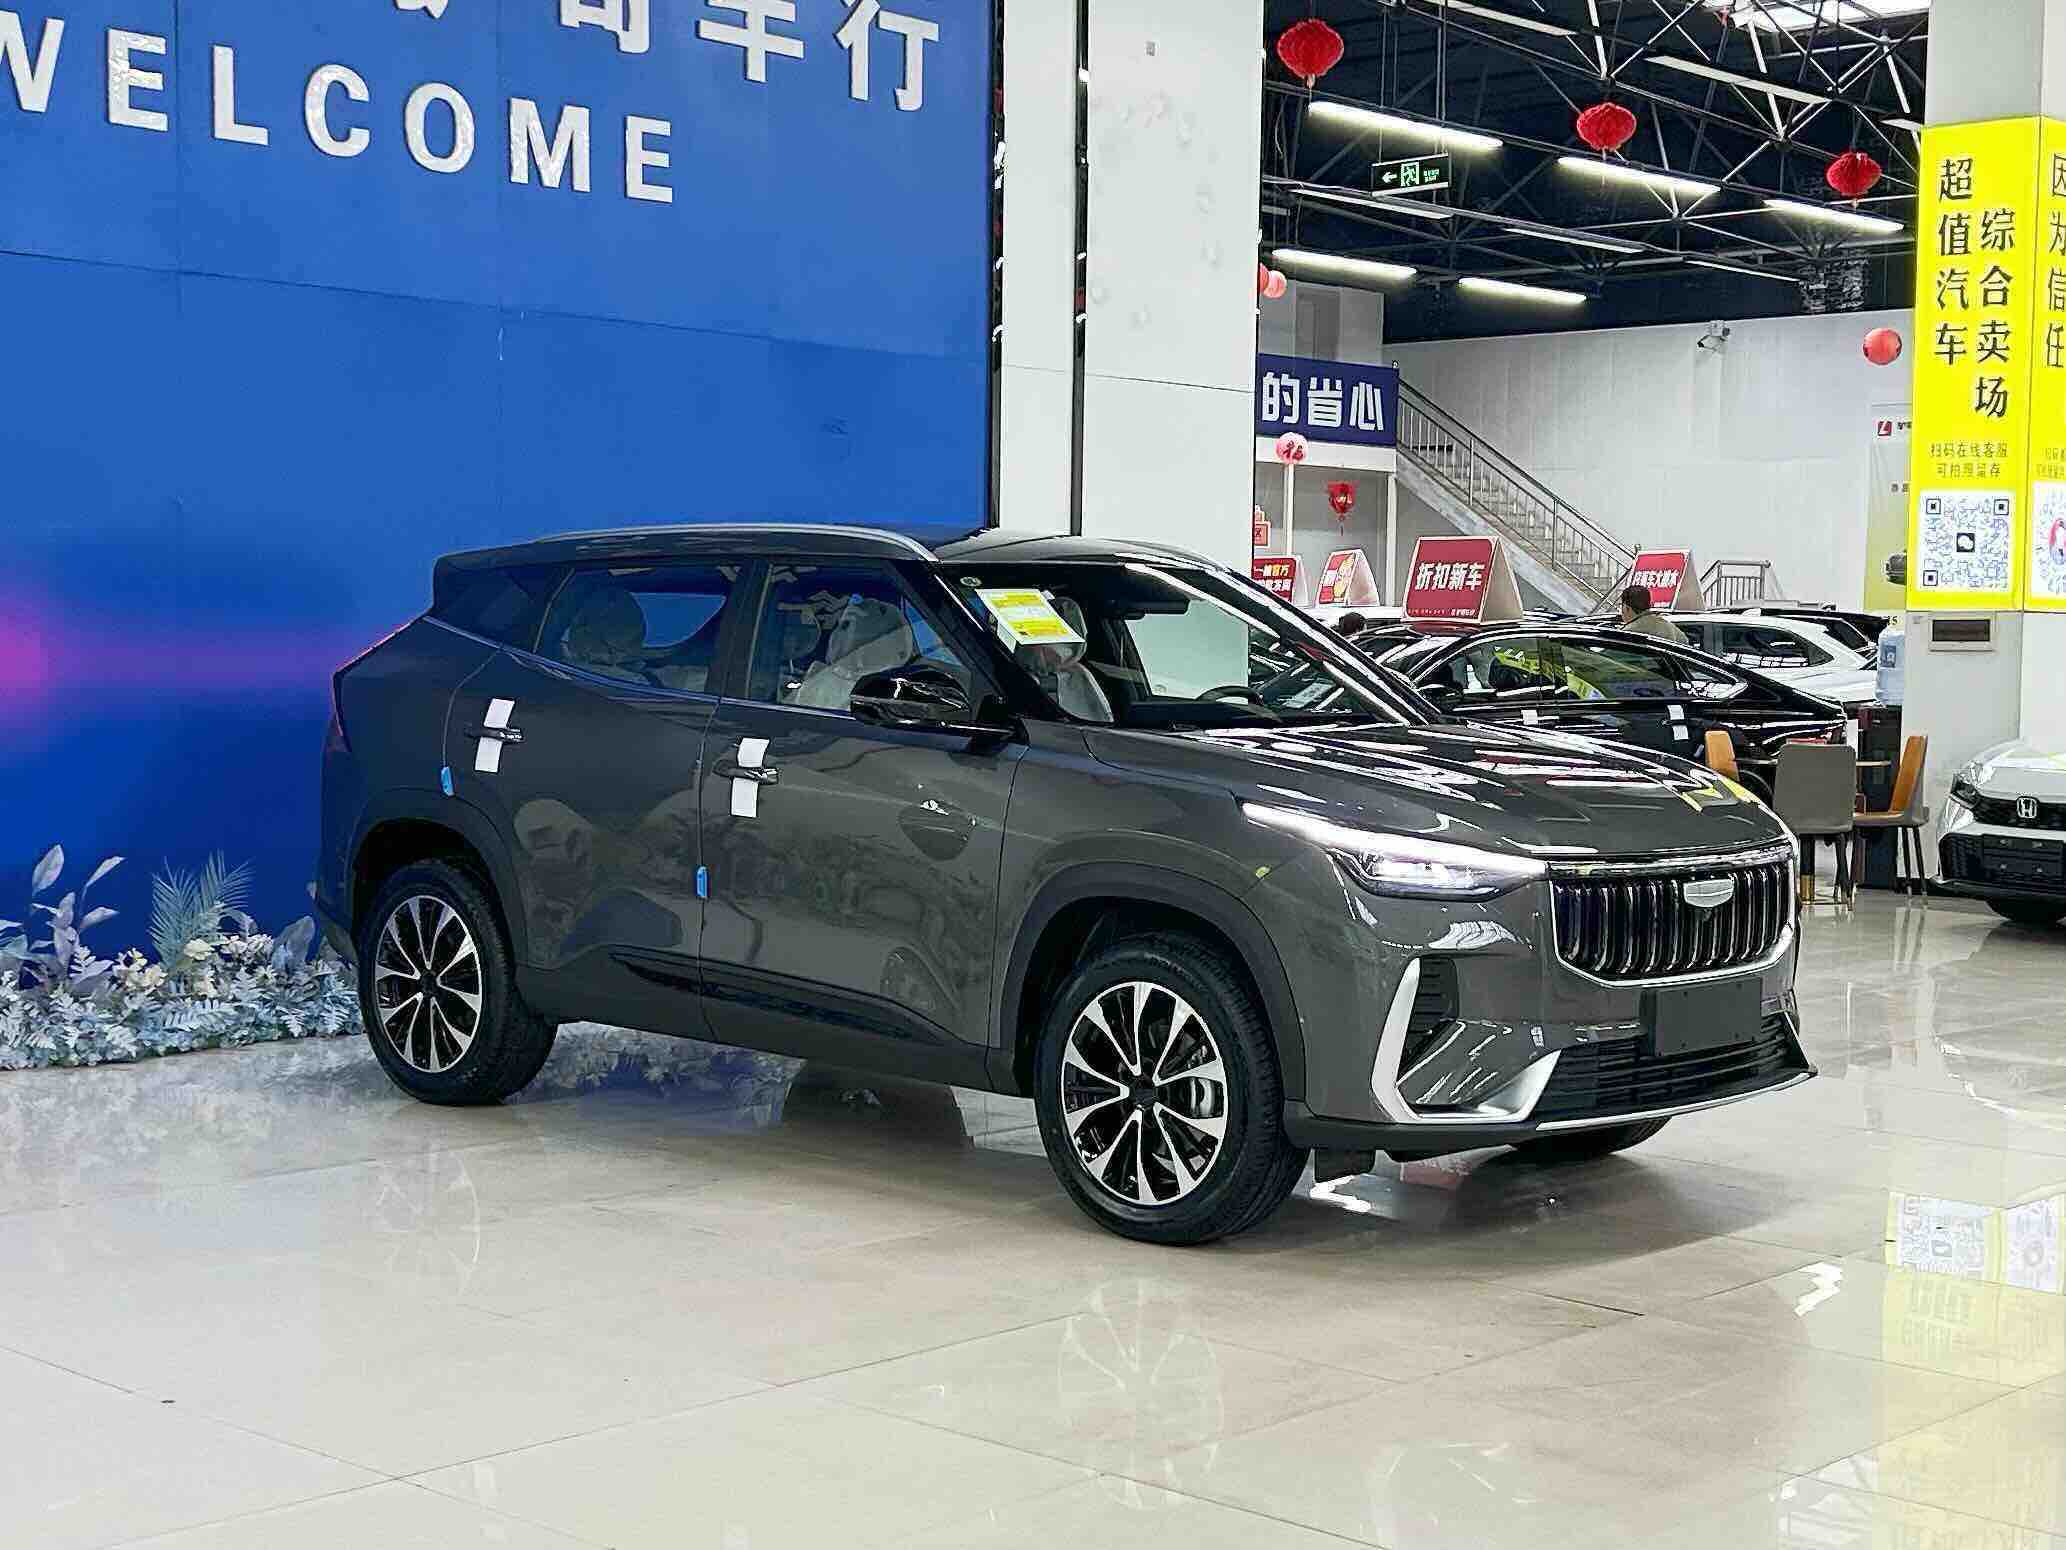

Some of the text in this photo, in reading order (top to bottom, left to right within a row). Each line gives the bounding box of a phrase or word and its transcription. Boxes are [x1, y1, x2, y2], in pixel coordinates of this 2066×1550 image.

[0, 10, 674, 203] WELCOME
[1934, 157, 1974, 366] 超值汽车
[1974, 207, 2016, 418] 综合卖场
[2046, 153, 2066, 368] 因为信任
[1261, 371, 1384, 431] 的省心
[1414, 562, 1485, 591] 折扣新车
